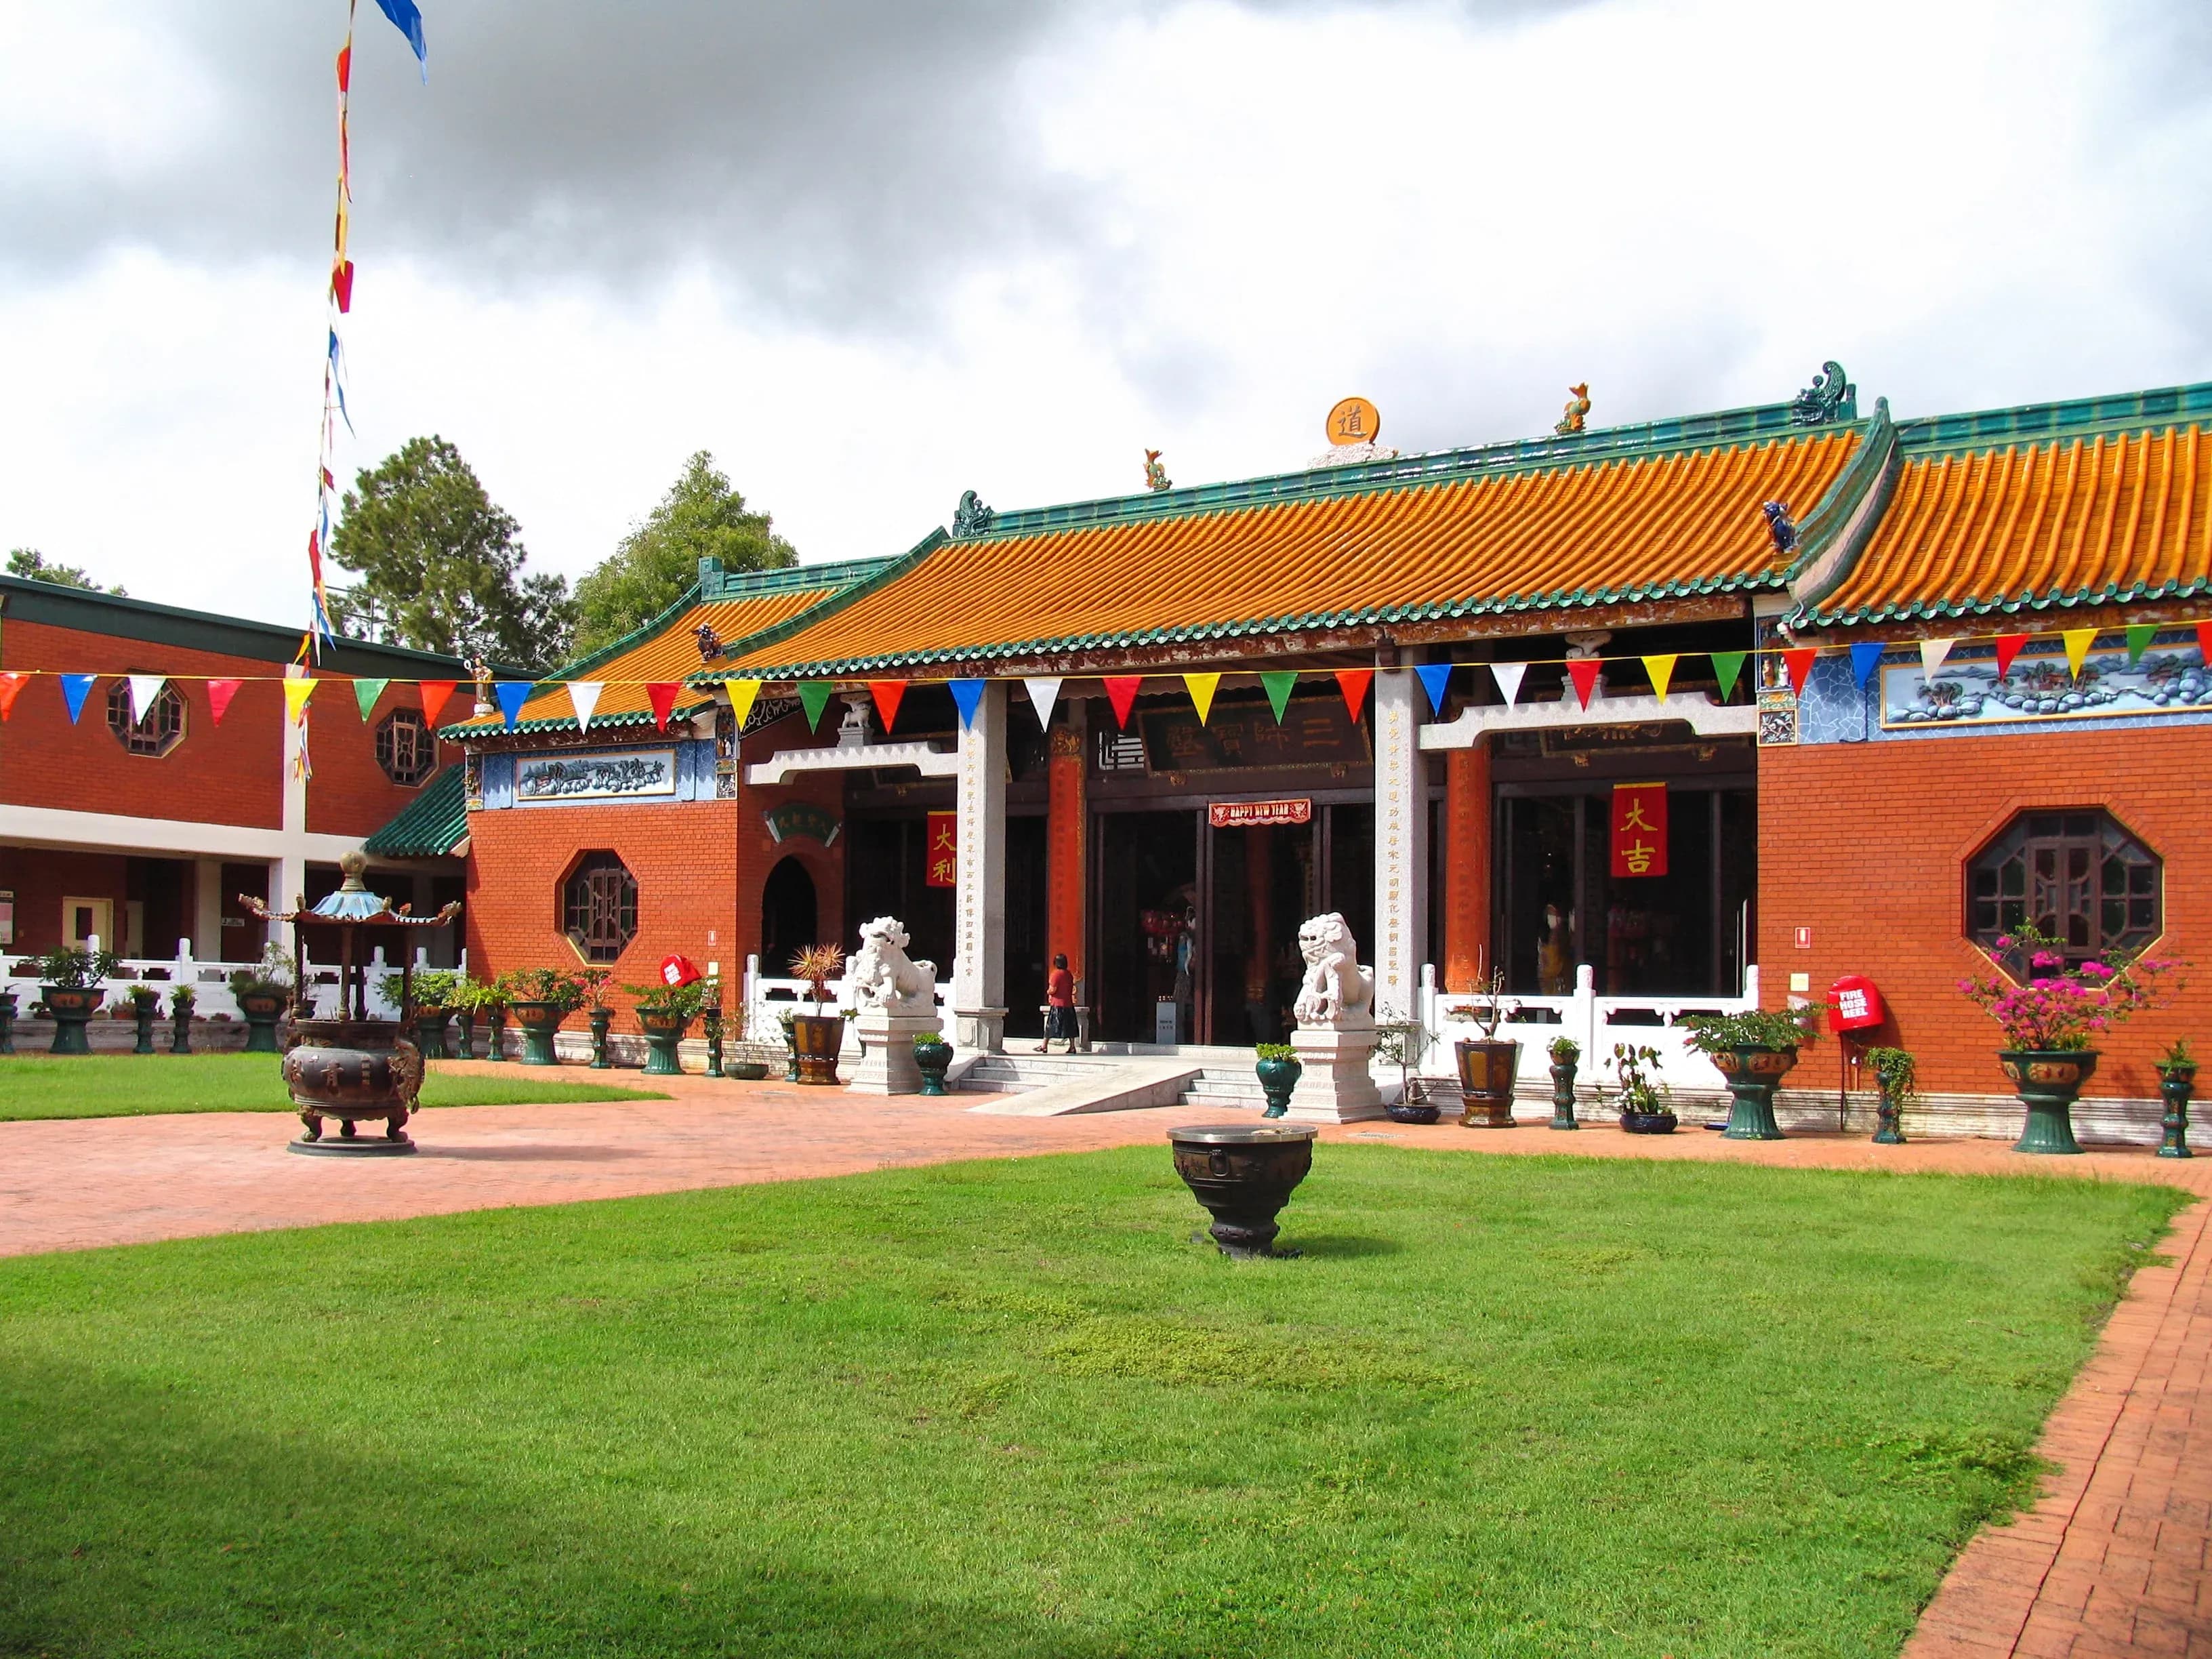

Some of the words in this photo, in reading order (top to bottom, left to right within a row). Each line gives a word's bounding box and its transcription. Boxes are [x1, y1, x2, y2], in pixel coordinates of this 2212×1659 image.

[1337, 403, 1368, 438] 道
[1229, 806, 1253, 818] HAPPY
[1254, 804, 1270, 817] NEW
[1271, 803, 1289, 816] YEAR
[1620, 798, 1658, 874] 大吉
[933, 823, 957, 884] 大利
[1839, 989, 1864, 1001] FIRE
[1839, 998, 1867, 1010] HOSE
[1842, 1007, 1868, 1019] REEL
